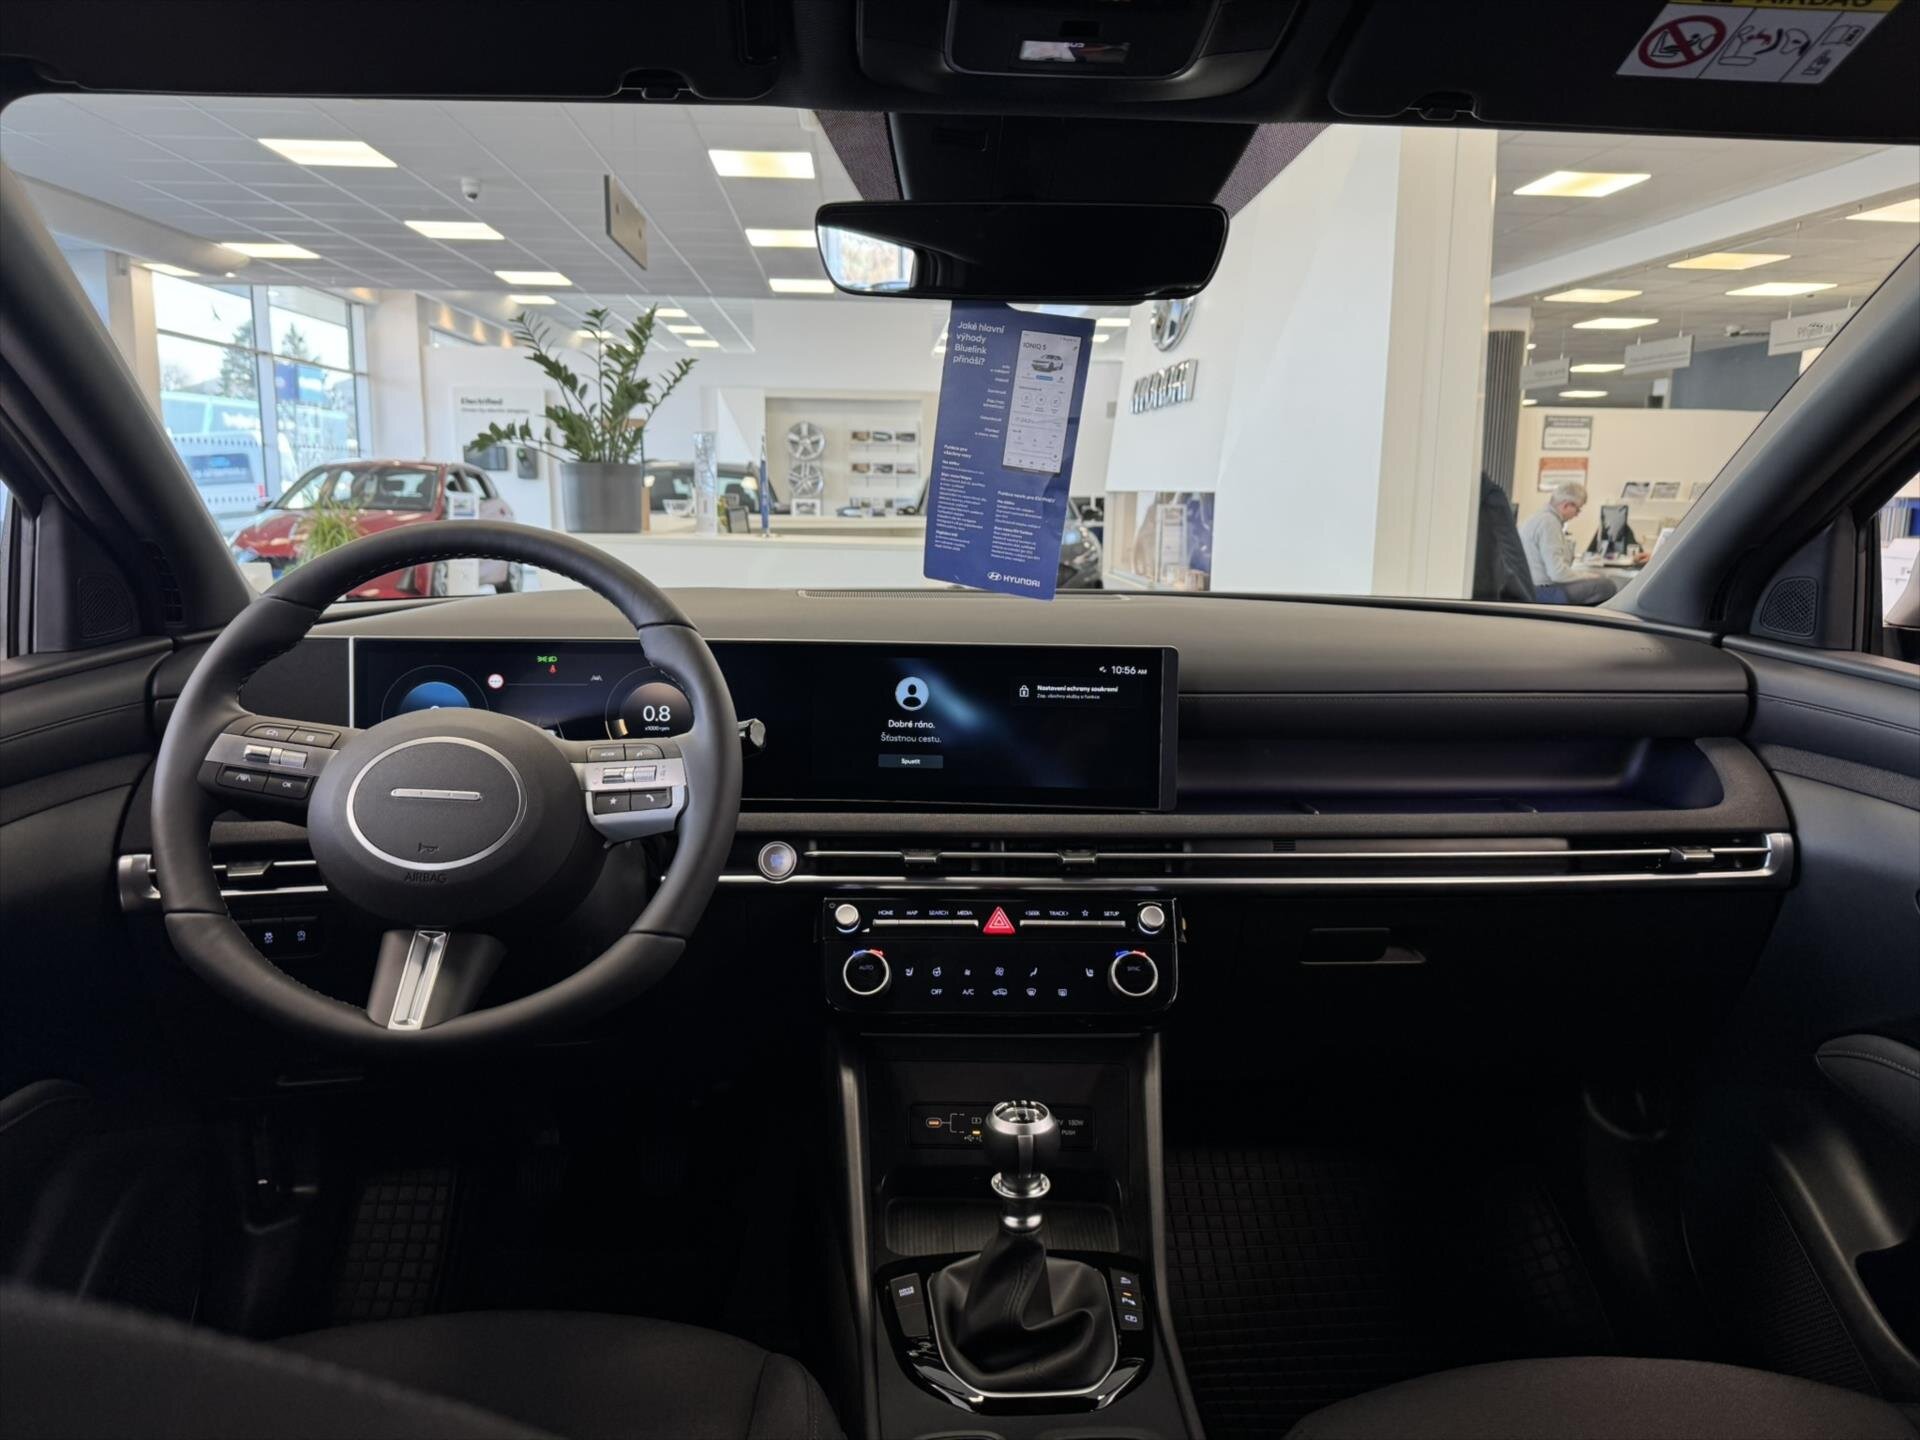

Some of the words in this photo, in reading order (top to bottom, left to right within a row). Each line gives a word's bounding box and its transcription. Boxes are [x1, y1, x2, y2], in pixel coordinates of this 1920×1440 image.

[958, 321, 977, 332] Jaké
[978, 324, 1005, 334] hlavní
[956, 332, 987, 344] výhody
[954, 343, 987, 354] Bluelink
[1003, 576, 1041, 588] HYUNDAI
[1111, 666, 1136, 675] 10:56
[1138, 668, 1148, 676] AM
[642, 705, 671, 722] 0.8
[888, 719, 913, 728] Dobré
[914, 720, 936, 729] ráno.
[404, 871, 449, 884] AIRBAG
[931, 988, 943, 996] OFF
[962, 988, 975, 996] A/C
